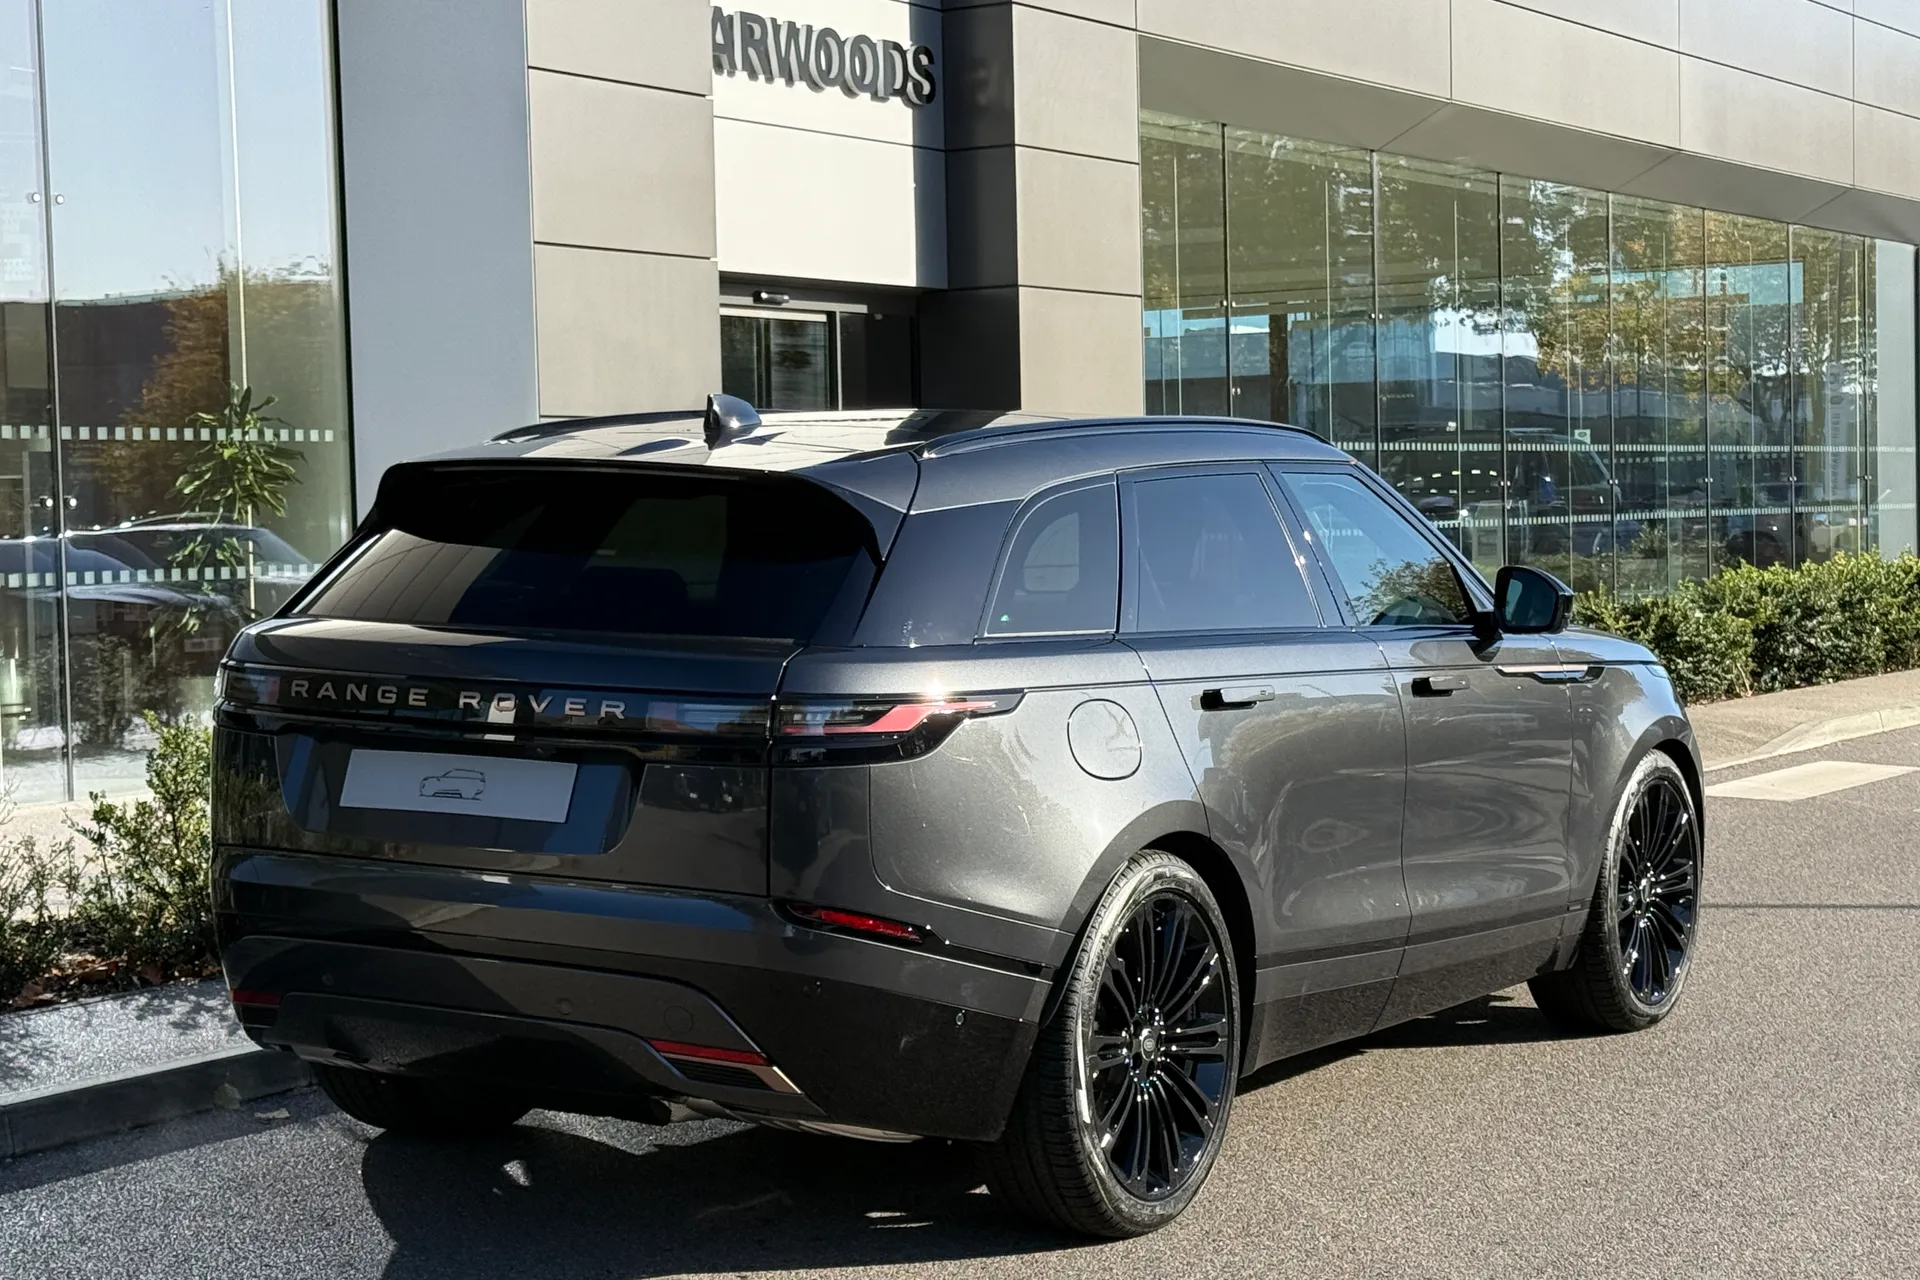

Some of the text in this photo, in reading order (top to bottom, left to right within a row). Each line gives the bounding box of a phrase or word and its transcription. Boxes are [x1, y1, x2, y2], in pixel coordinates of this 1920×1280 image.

[711, 6, 936, 104] ARWOODS
[290, 679, 626, 720] RANGE ROVER
